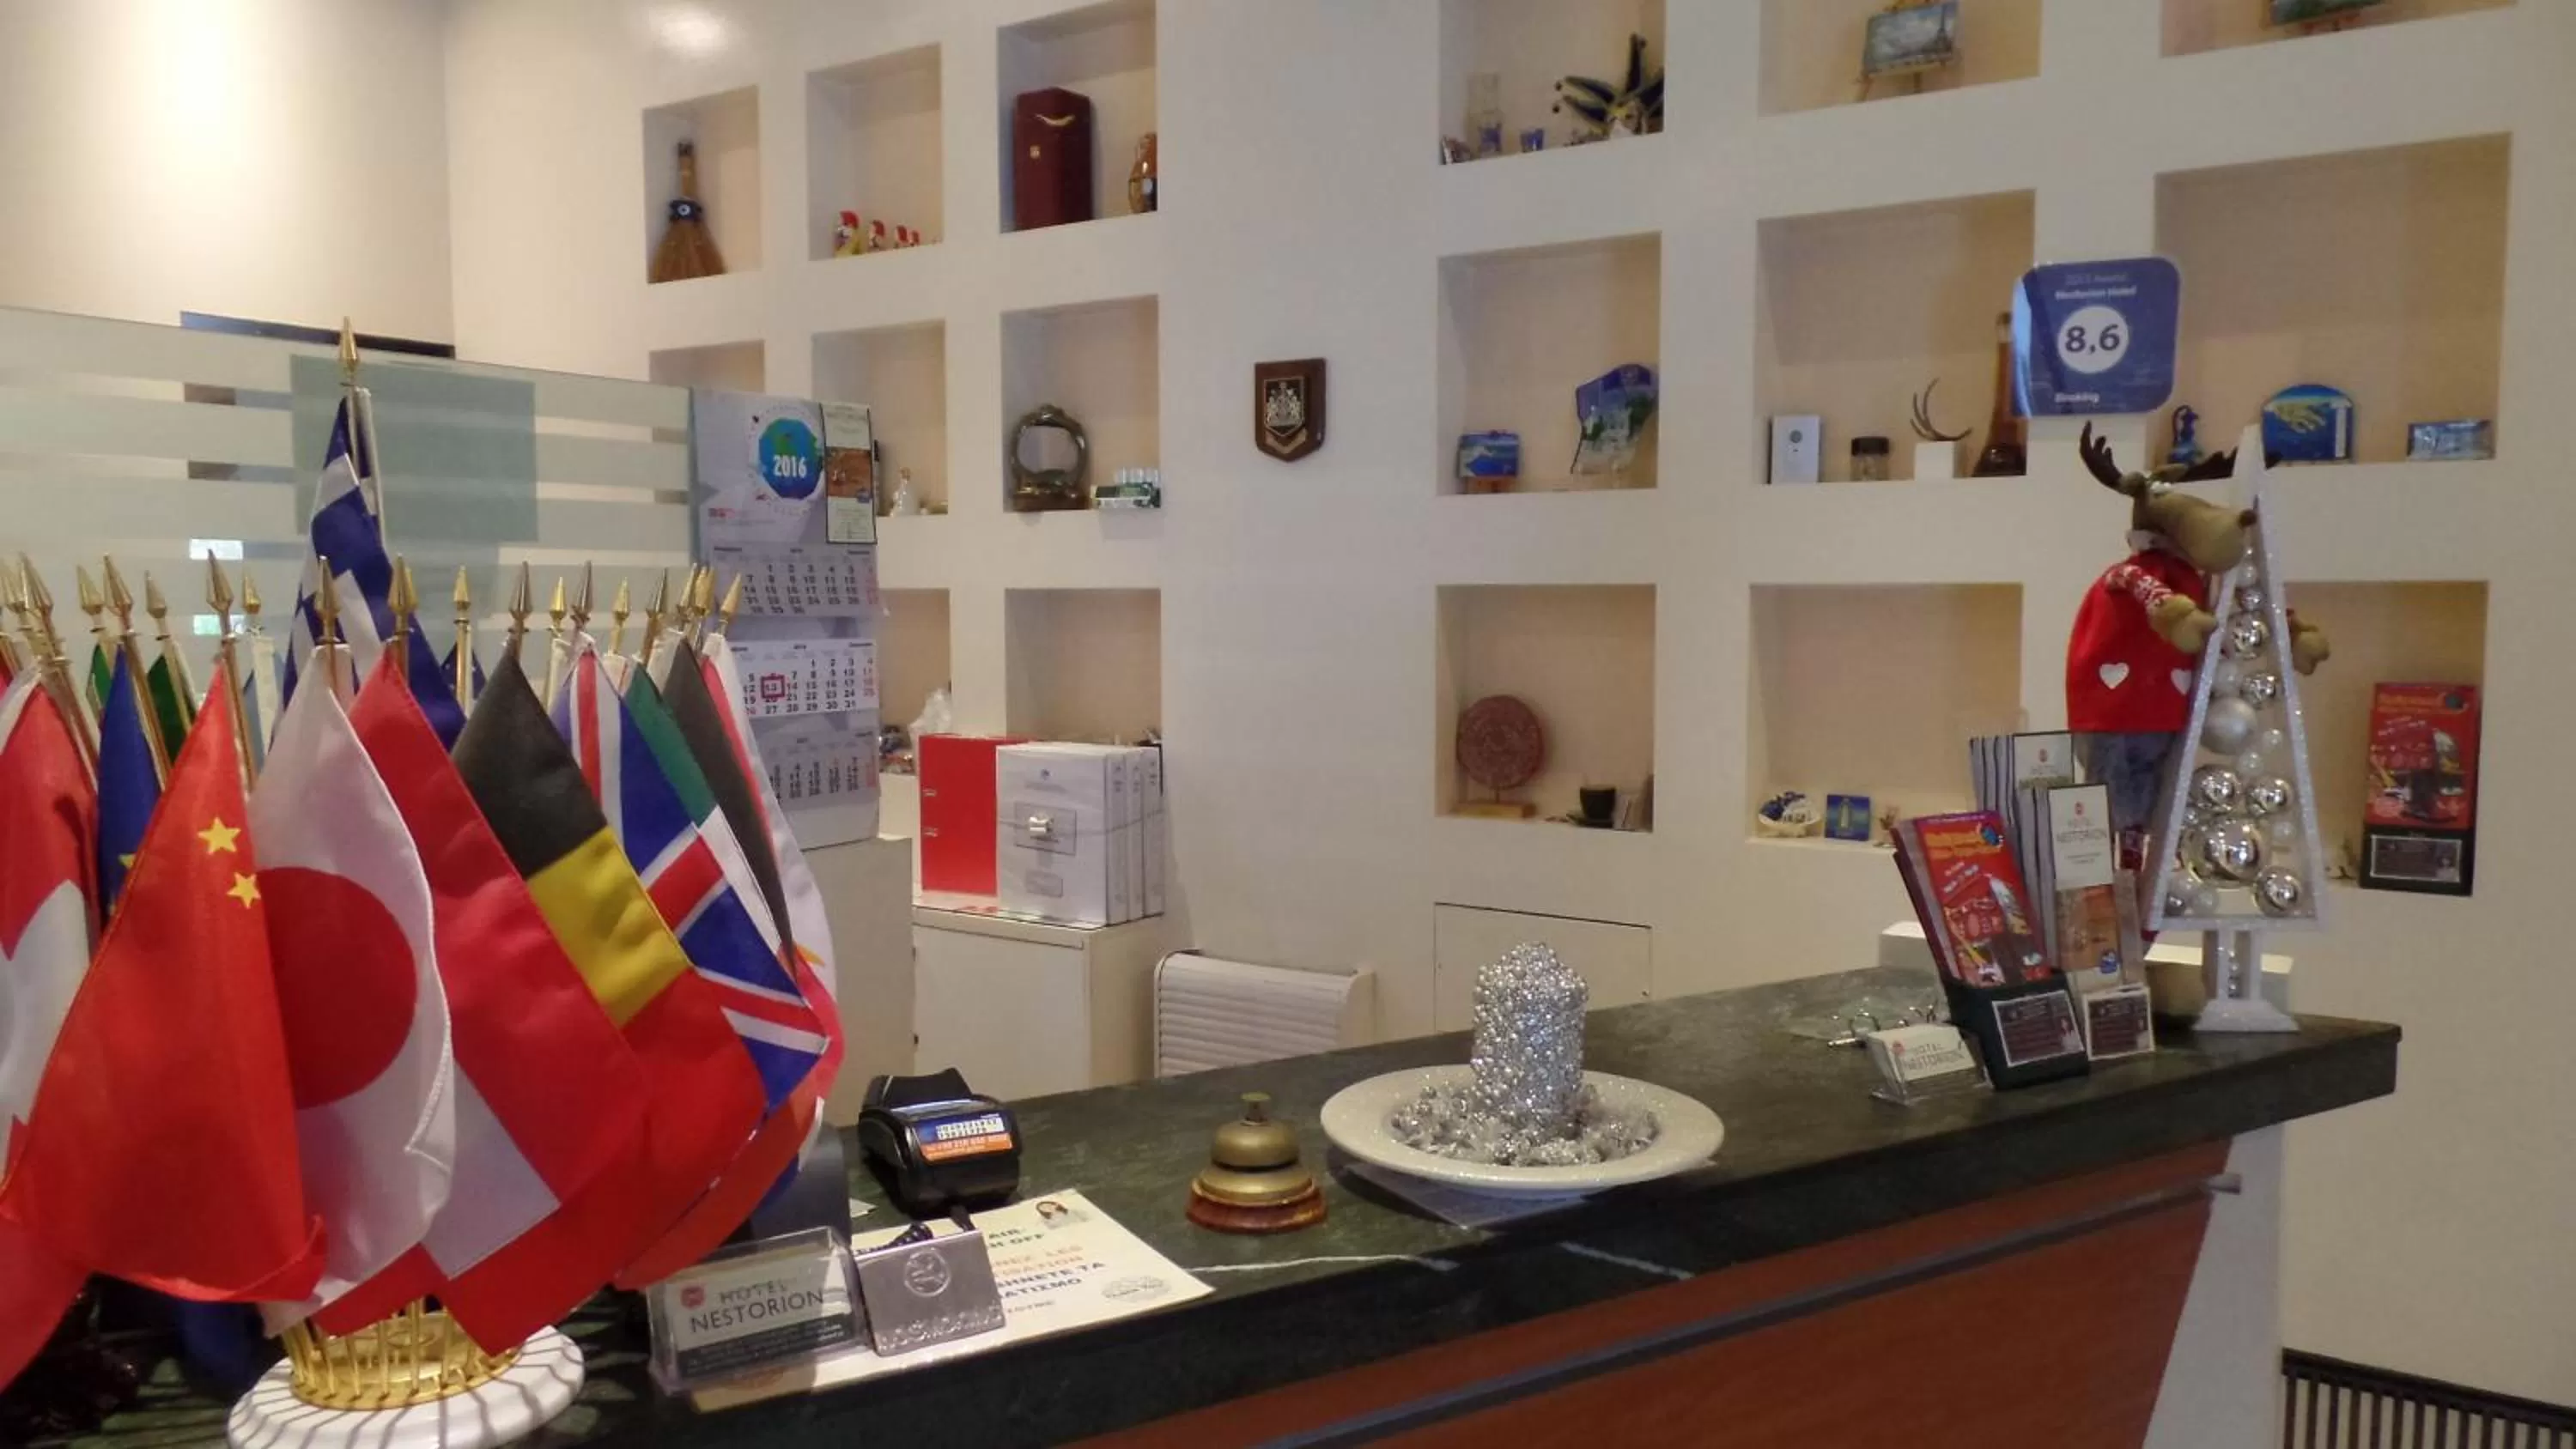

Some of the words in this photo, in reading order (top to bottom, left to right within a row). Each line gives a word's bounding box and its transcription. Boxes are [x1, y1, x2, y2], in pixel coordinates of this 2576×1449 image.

[2064, 324, 2121, 355] 8,6
[772, 455, 808, 478] 2016
[720, 1280, 787, 1303] HOTEL
[690, 1290, 823, 1332] NESTORION
